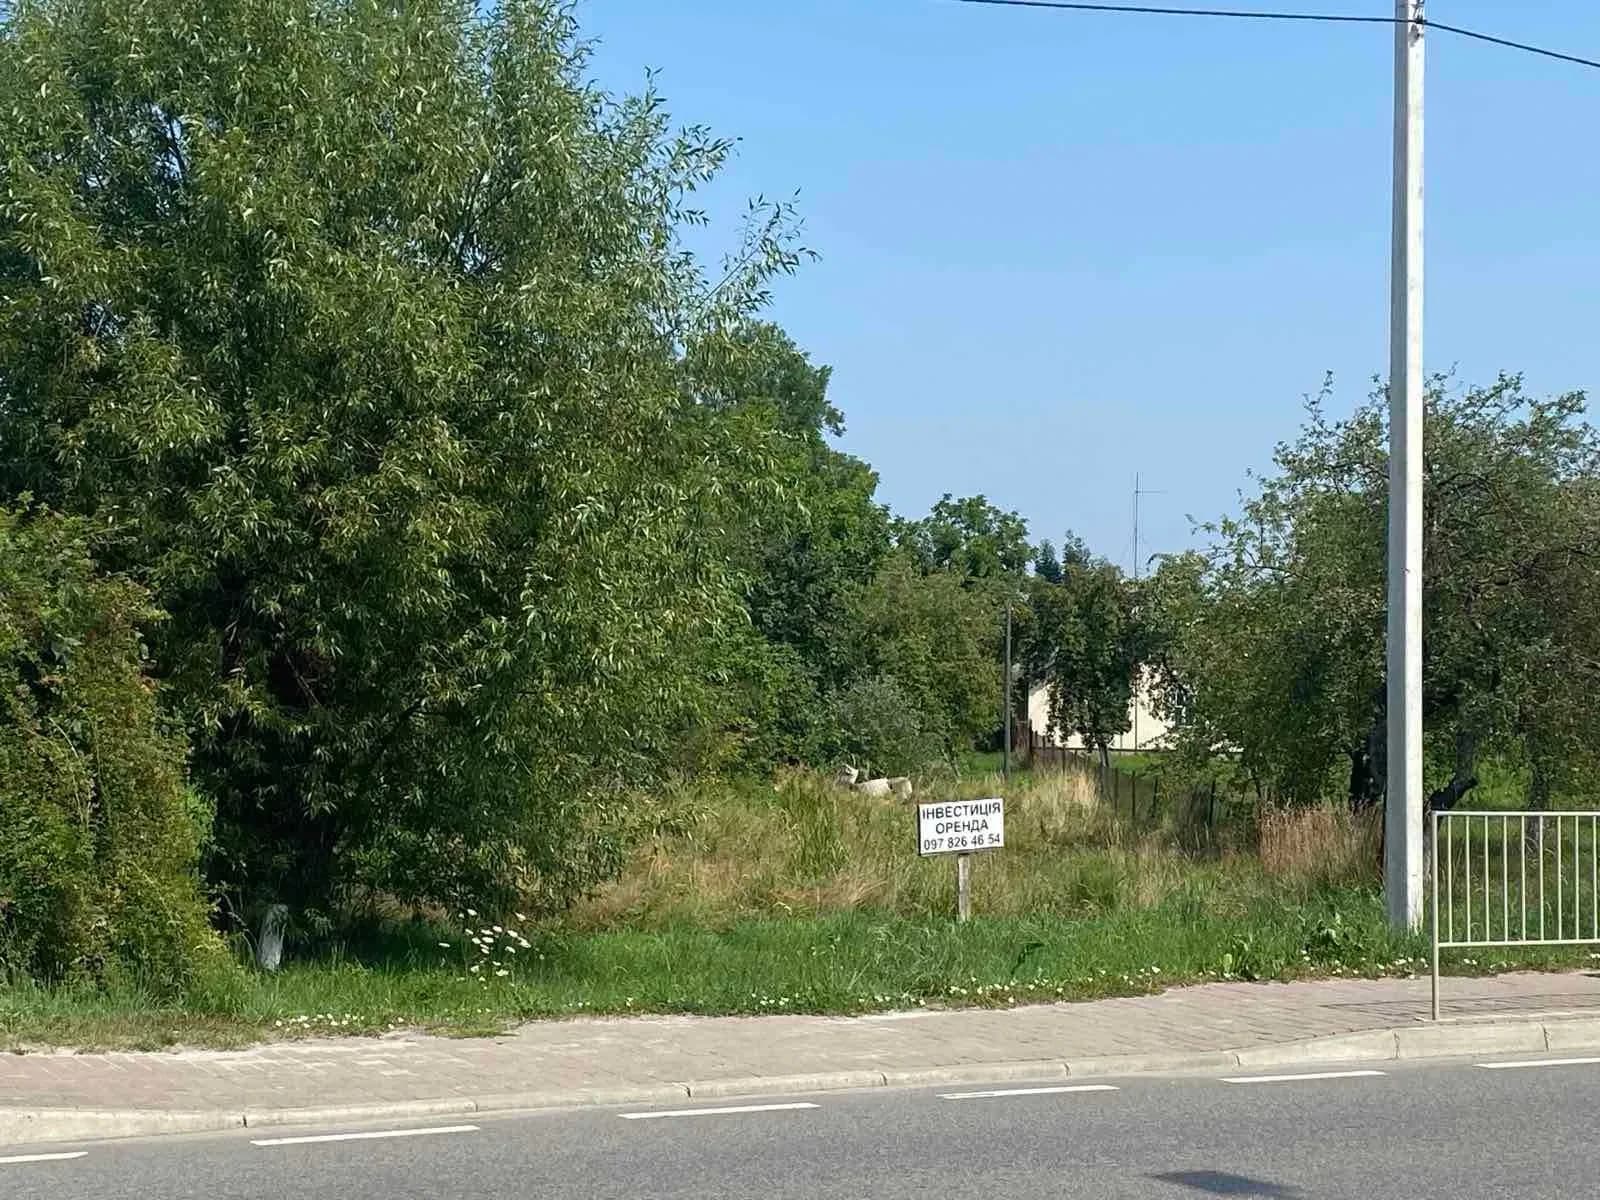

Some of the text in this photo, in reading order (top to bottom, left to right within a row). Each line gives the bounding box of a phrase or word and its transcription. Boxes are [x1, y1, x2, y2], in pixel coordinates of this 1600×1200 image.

[922, 802, 1001, 820] ІНВЕСТИЦІЯ
[935, 819, 989, 834] ОРЕНДА
[923, 833, 1001, 850] 097 826 46 54
